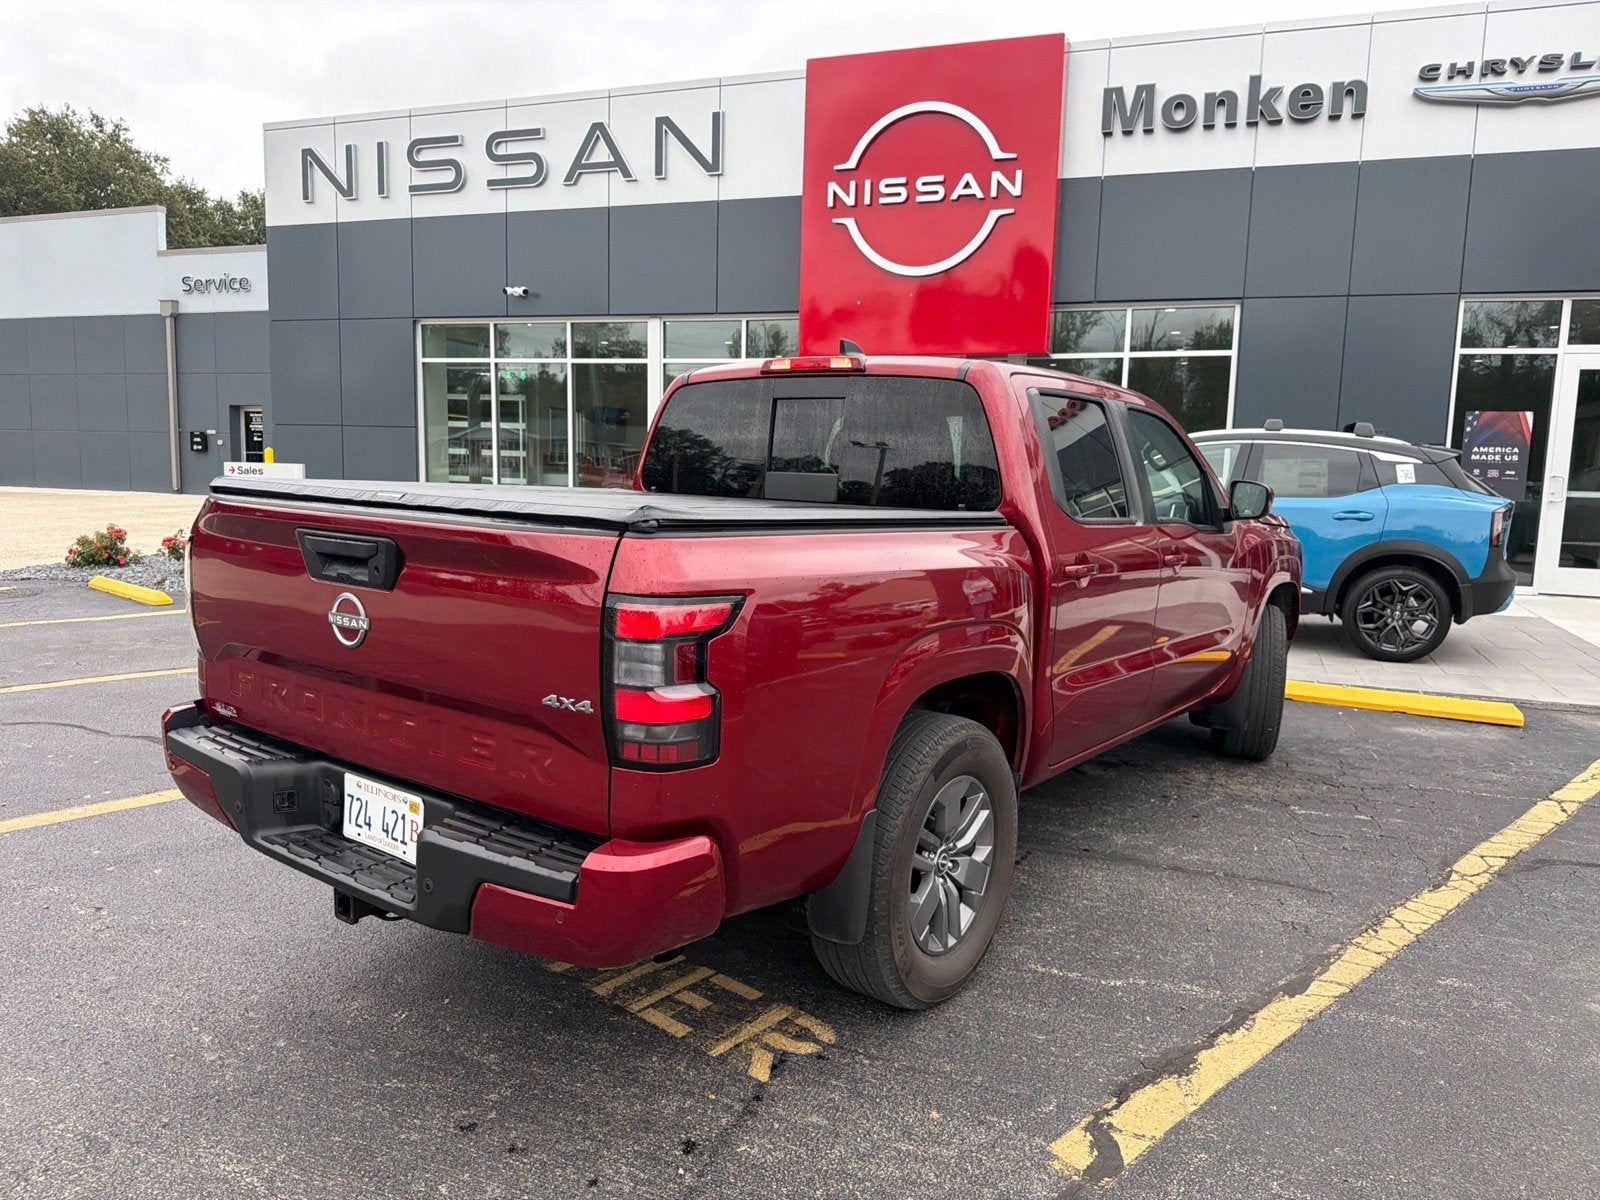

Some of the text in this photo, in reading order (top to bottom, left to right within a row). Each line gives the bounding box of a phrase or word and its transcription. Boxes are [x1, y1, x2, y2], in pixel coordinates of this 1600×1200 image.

[1418, 51, 1600, 82] CHRYSL
[1101, 73, 1369, 137] Monken
[301, 109, 724, 203] NISSAN
[826, 169, 1023, 208] NISSAN
[181, 273, 251, 294] Service
[237, 465, 264, 475] Sales
[328, 612, 367, 629] NISSAN
[363, 783, 402, 804] ILLINOIS
[346, 793, 372, 832] 724
[382, 806, 408, 846] 421
